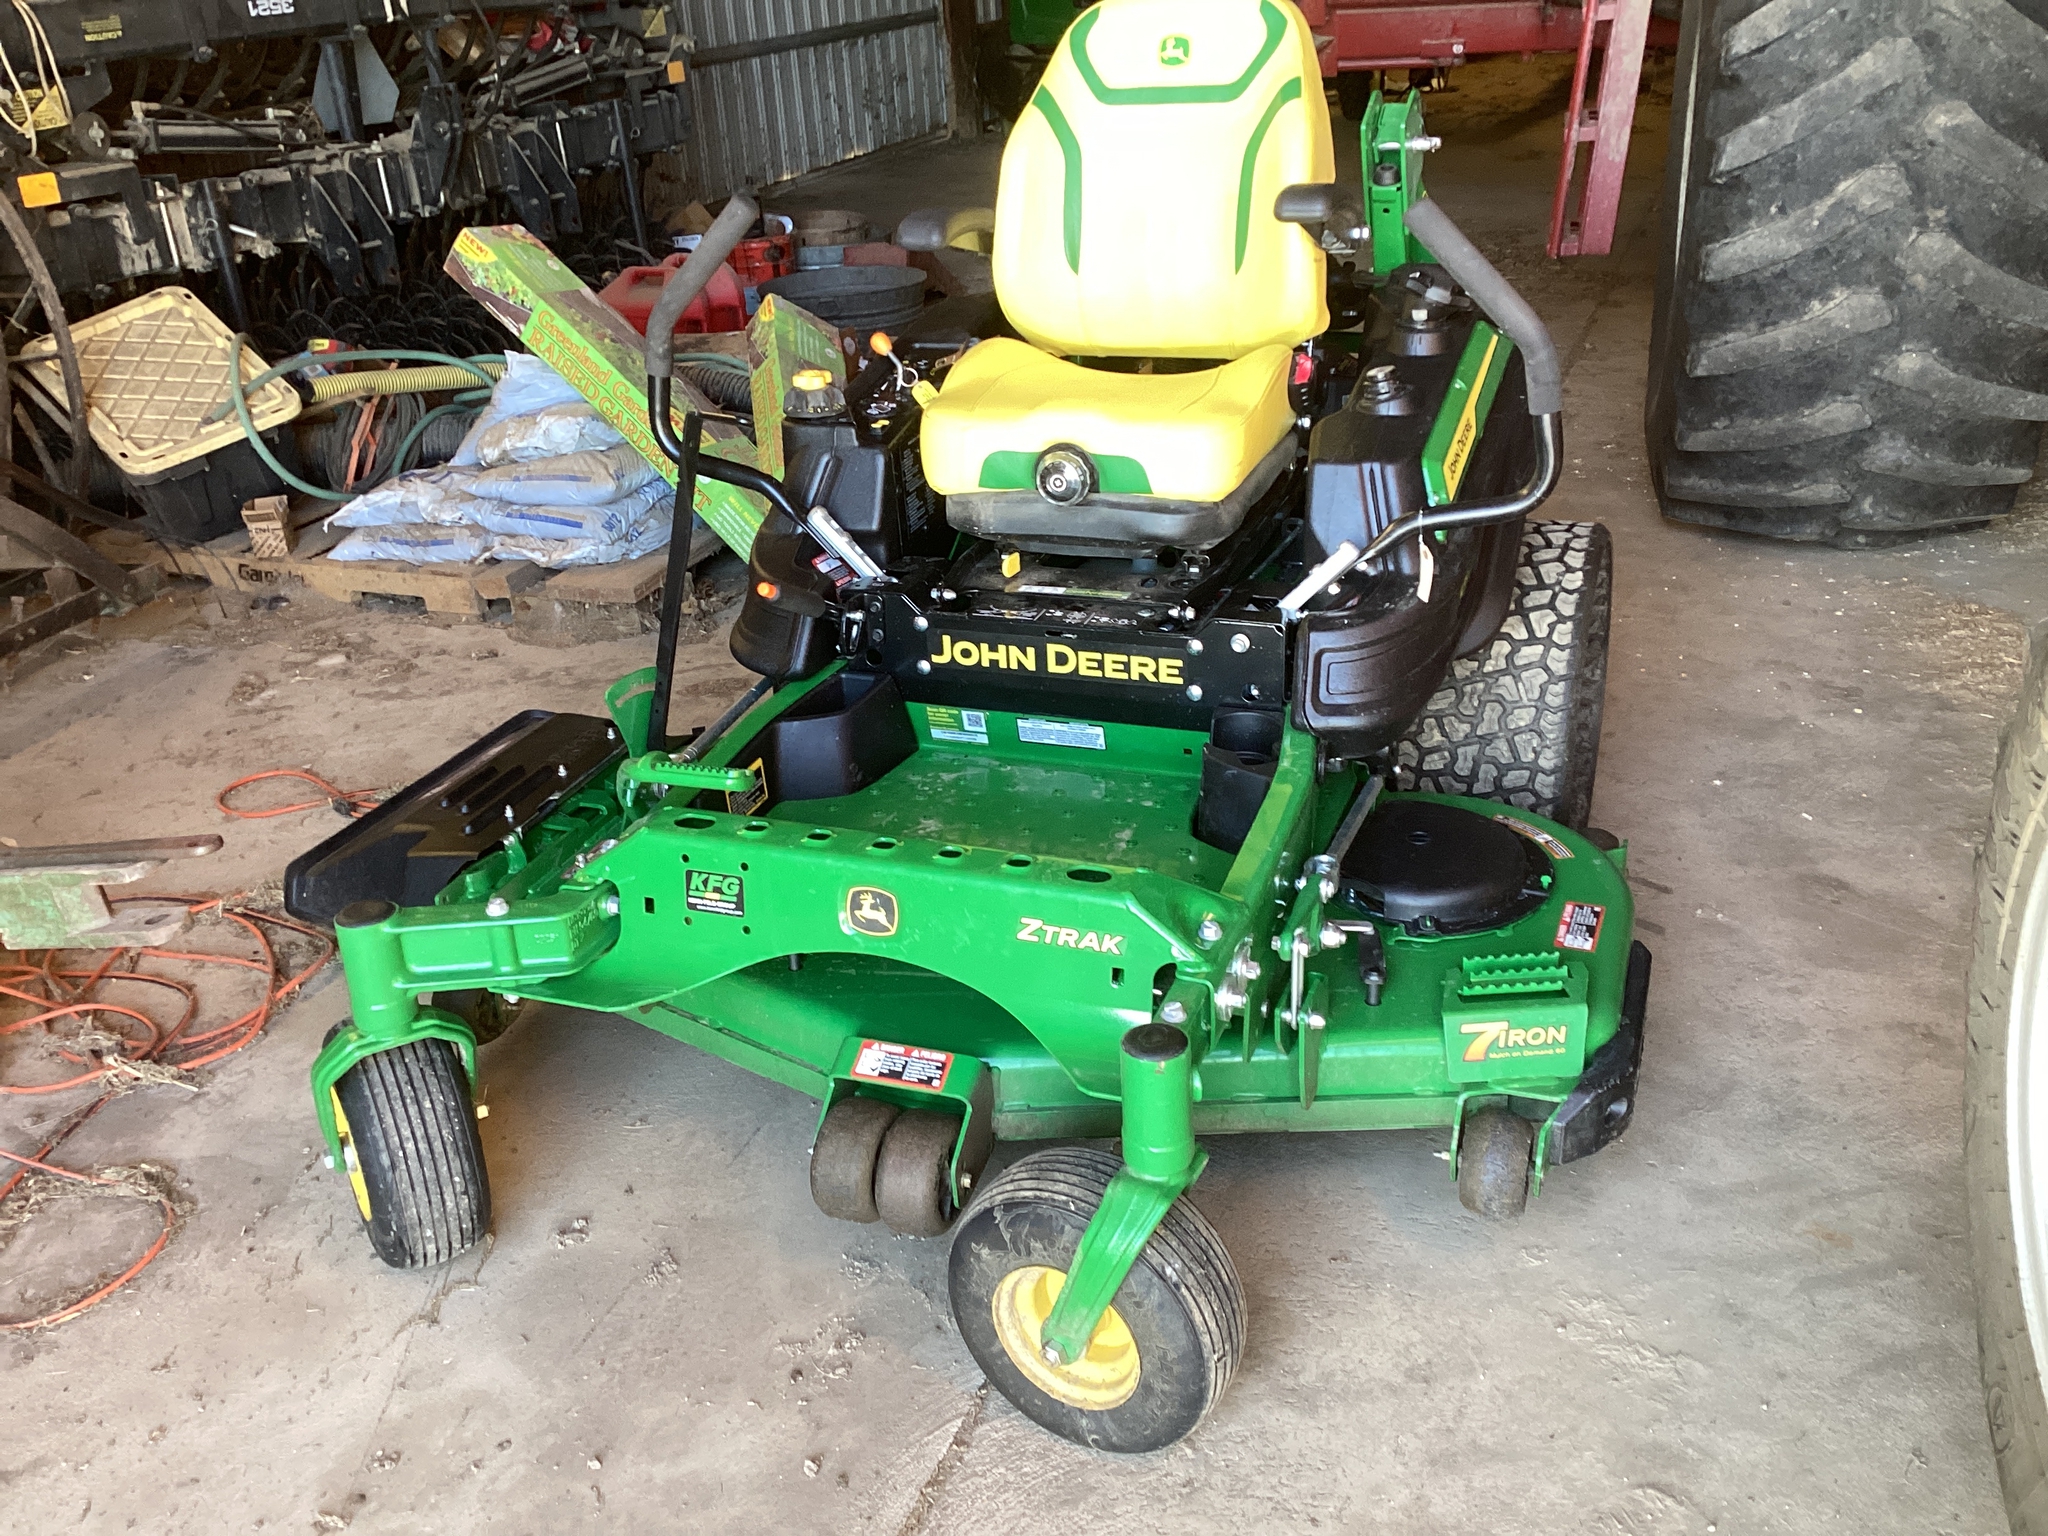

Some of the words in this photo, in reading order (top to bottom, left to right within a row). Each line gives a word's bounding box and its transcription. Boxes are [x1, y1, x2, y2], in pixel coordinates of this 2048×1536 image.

[462, 232, 489, 258] NEW!
[538, 310, 612, 386] Greenland
[527, 327, 600, 401] RAISED
[599, 397, 677, 479] GARDEN
[1448, 448, 1461, 481] JOHN
[1457, 417, 1472, 453] DEERE
[931, 634, 1036, 671] JOHN
[1046, 643, 1184, 685] DEERE
[690, 871, 740, 896] KFG
[1016, 916, 1126, 956] ZTRAK
